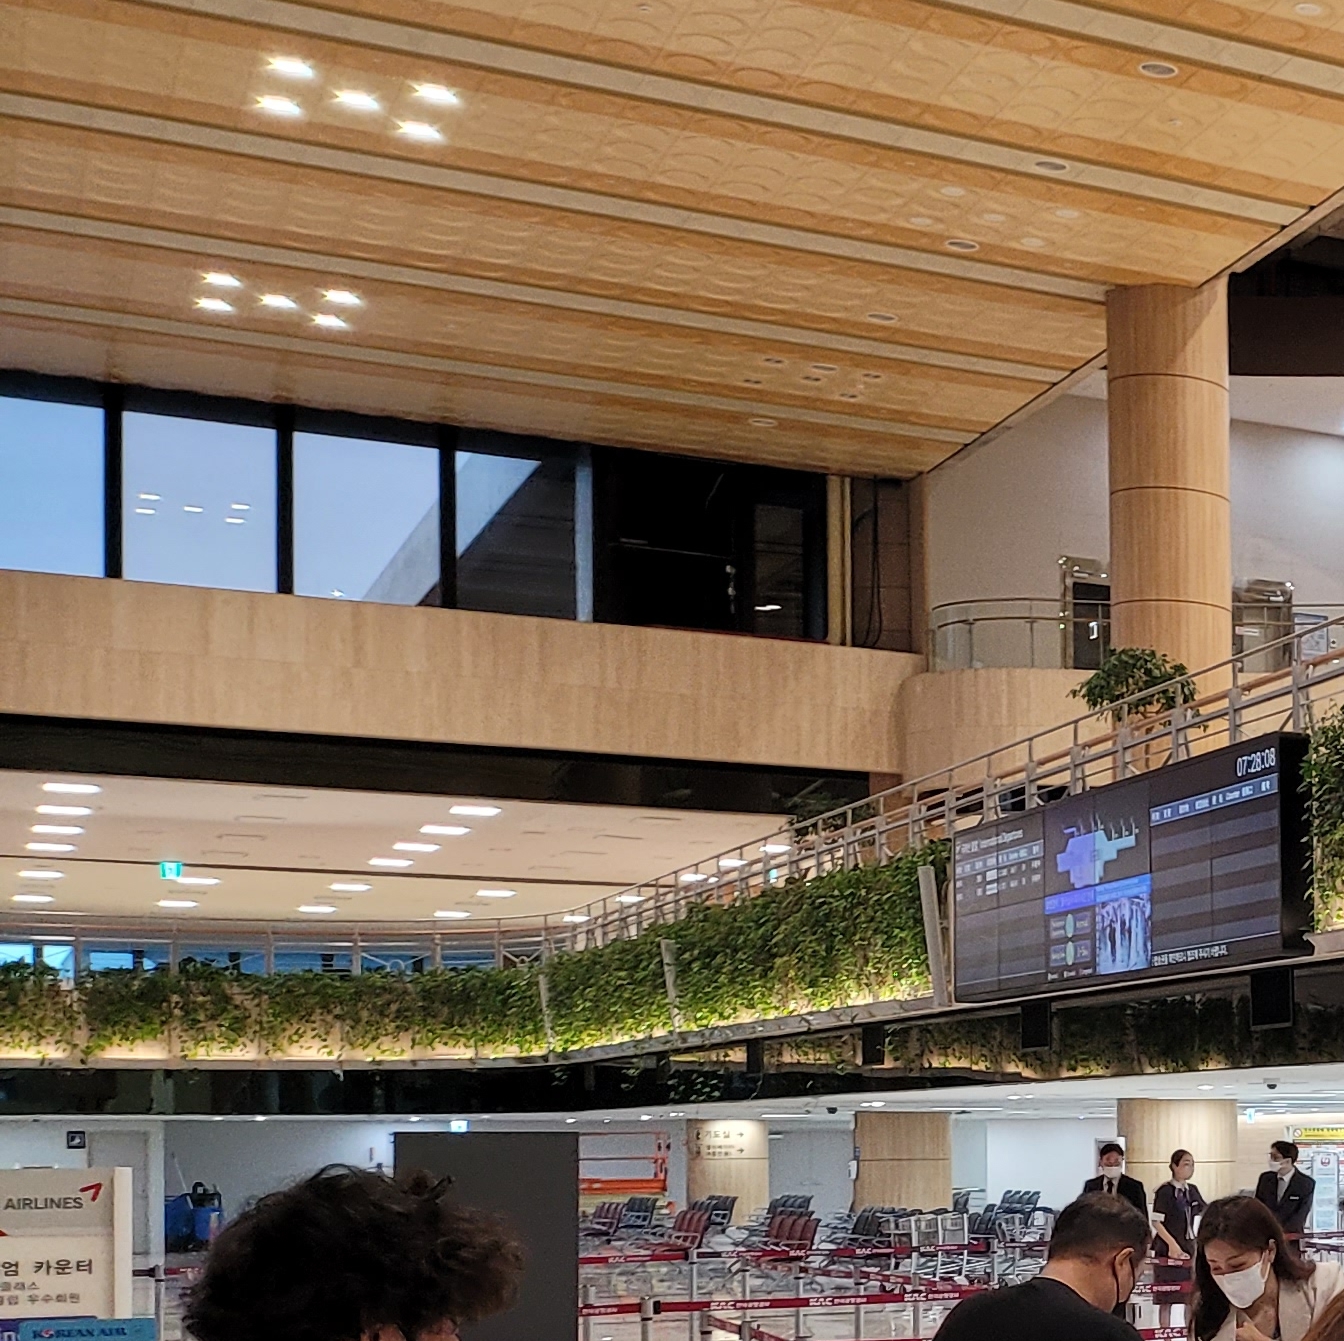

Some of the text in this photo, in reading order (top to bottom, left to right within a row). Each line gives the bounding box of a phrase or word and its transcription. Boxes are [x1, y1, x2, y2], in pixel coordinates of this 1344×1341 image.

[1237, 748, 1275, 777] 07:28:08
[704, 1130, 731, 1139] 기도실
[4, 1197, 84, 1210] AIRLINES
[34, 1259, 93, 1276] 카운터
[100, 1327, 127, 1337] AIR
